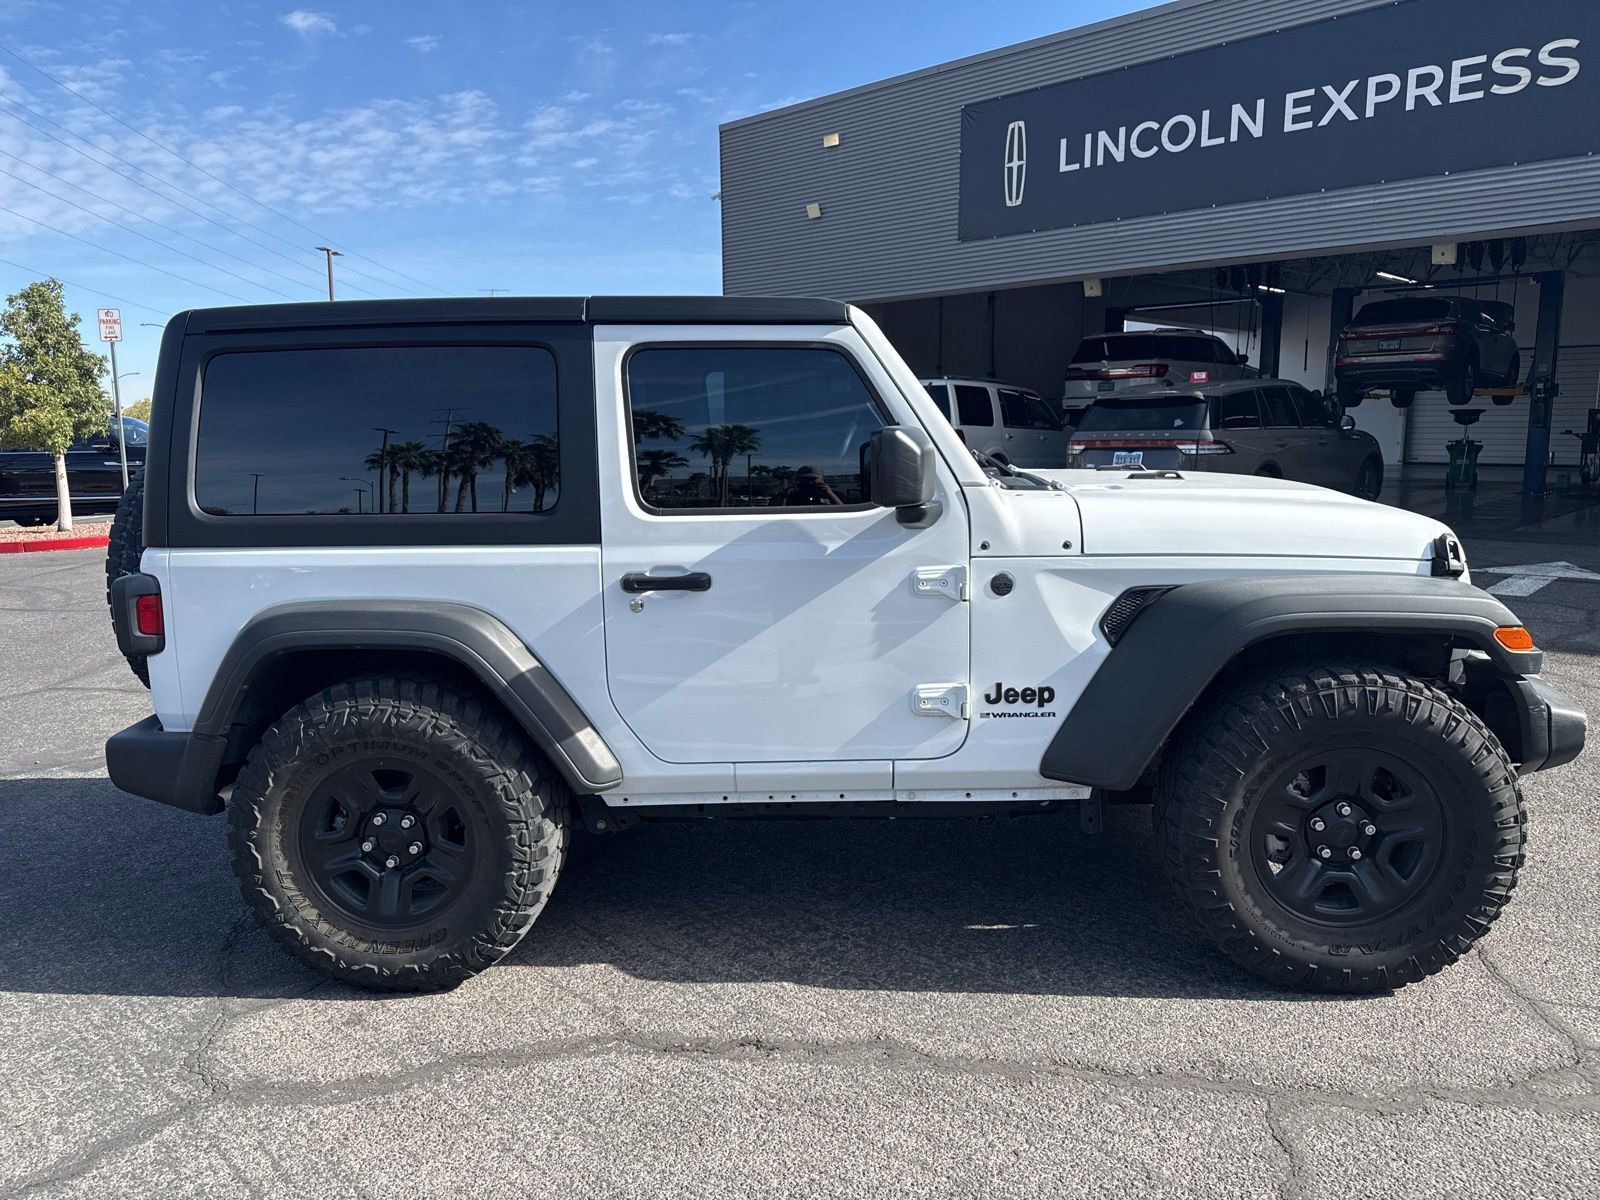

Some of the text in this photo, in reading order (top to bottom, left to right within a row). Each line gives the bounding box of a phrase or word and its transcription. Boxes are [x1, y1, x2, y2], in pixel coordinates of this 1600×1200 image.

[1059, 38, 1580, 173] LINCOLN EXPRESS
[984, 682, 1056, 708] Jeep
[316, 740, 428, 766] OPTIMUM
[275, 868, 448, 955] GREEN MAX M/T
